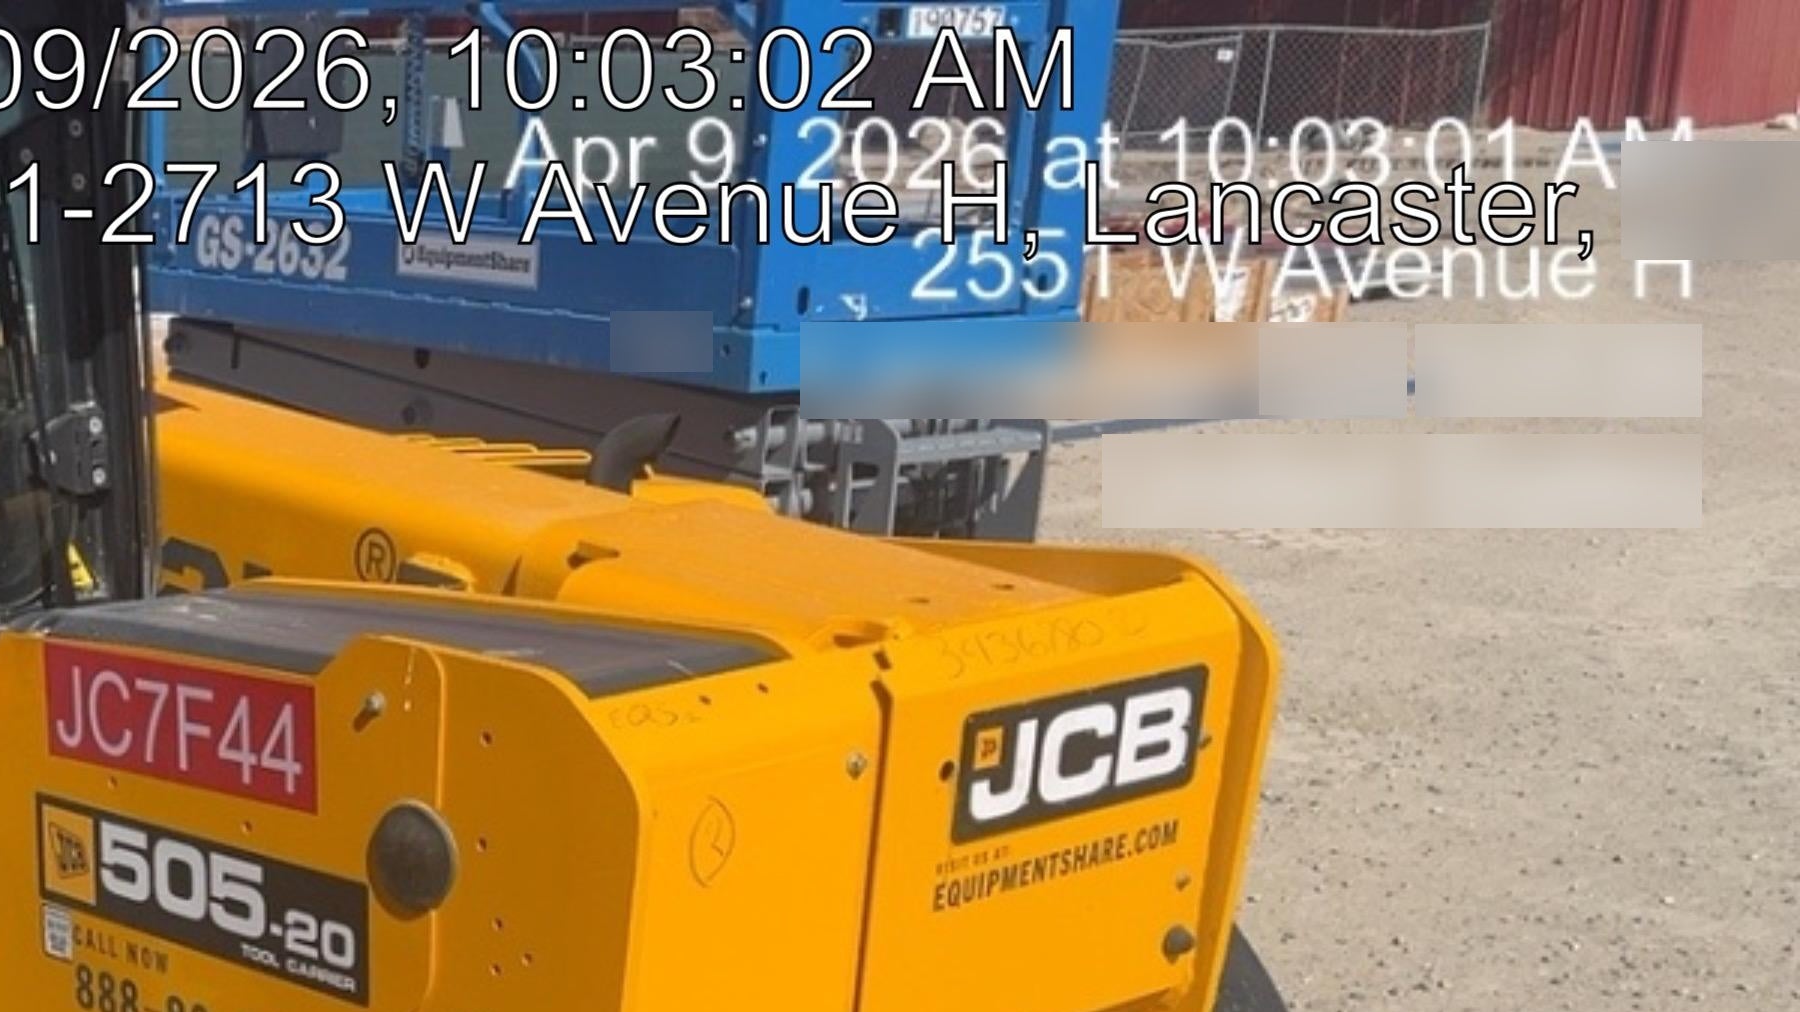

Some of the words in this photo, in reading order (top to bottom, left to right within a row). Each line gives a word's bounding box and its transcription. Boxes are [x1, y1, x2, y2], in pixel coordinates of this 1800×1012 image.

[56, 665, 302, 794] JC7F44
[969, 686, 1192, 821] JCB
[932, 819, 1179, 913] EQUIPMENTSHARE.COM
[72, 923, 118, 958] CALL
[125, 940, 169, 975] NOW
